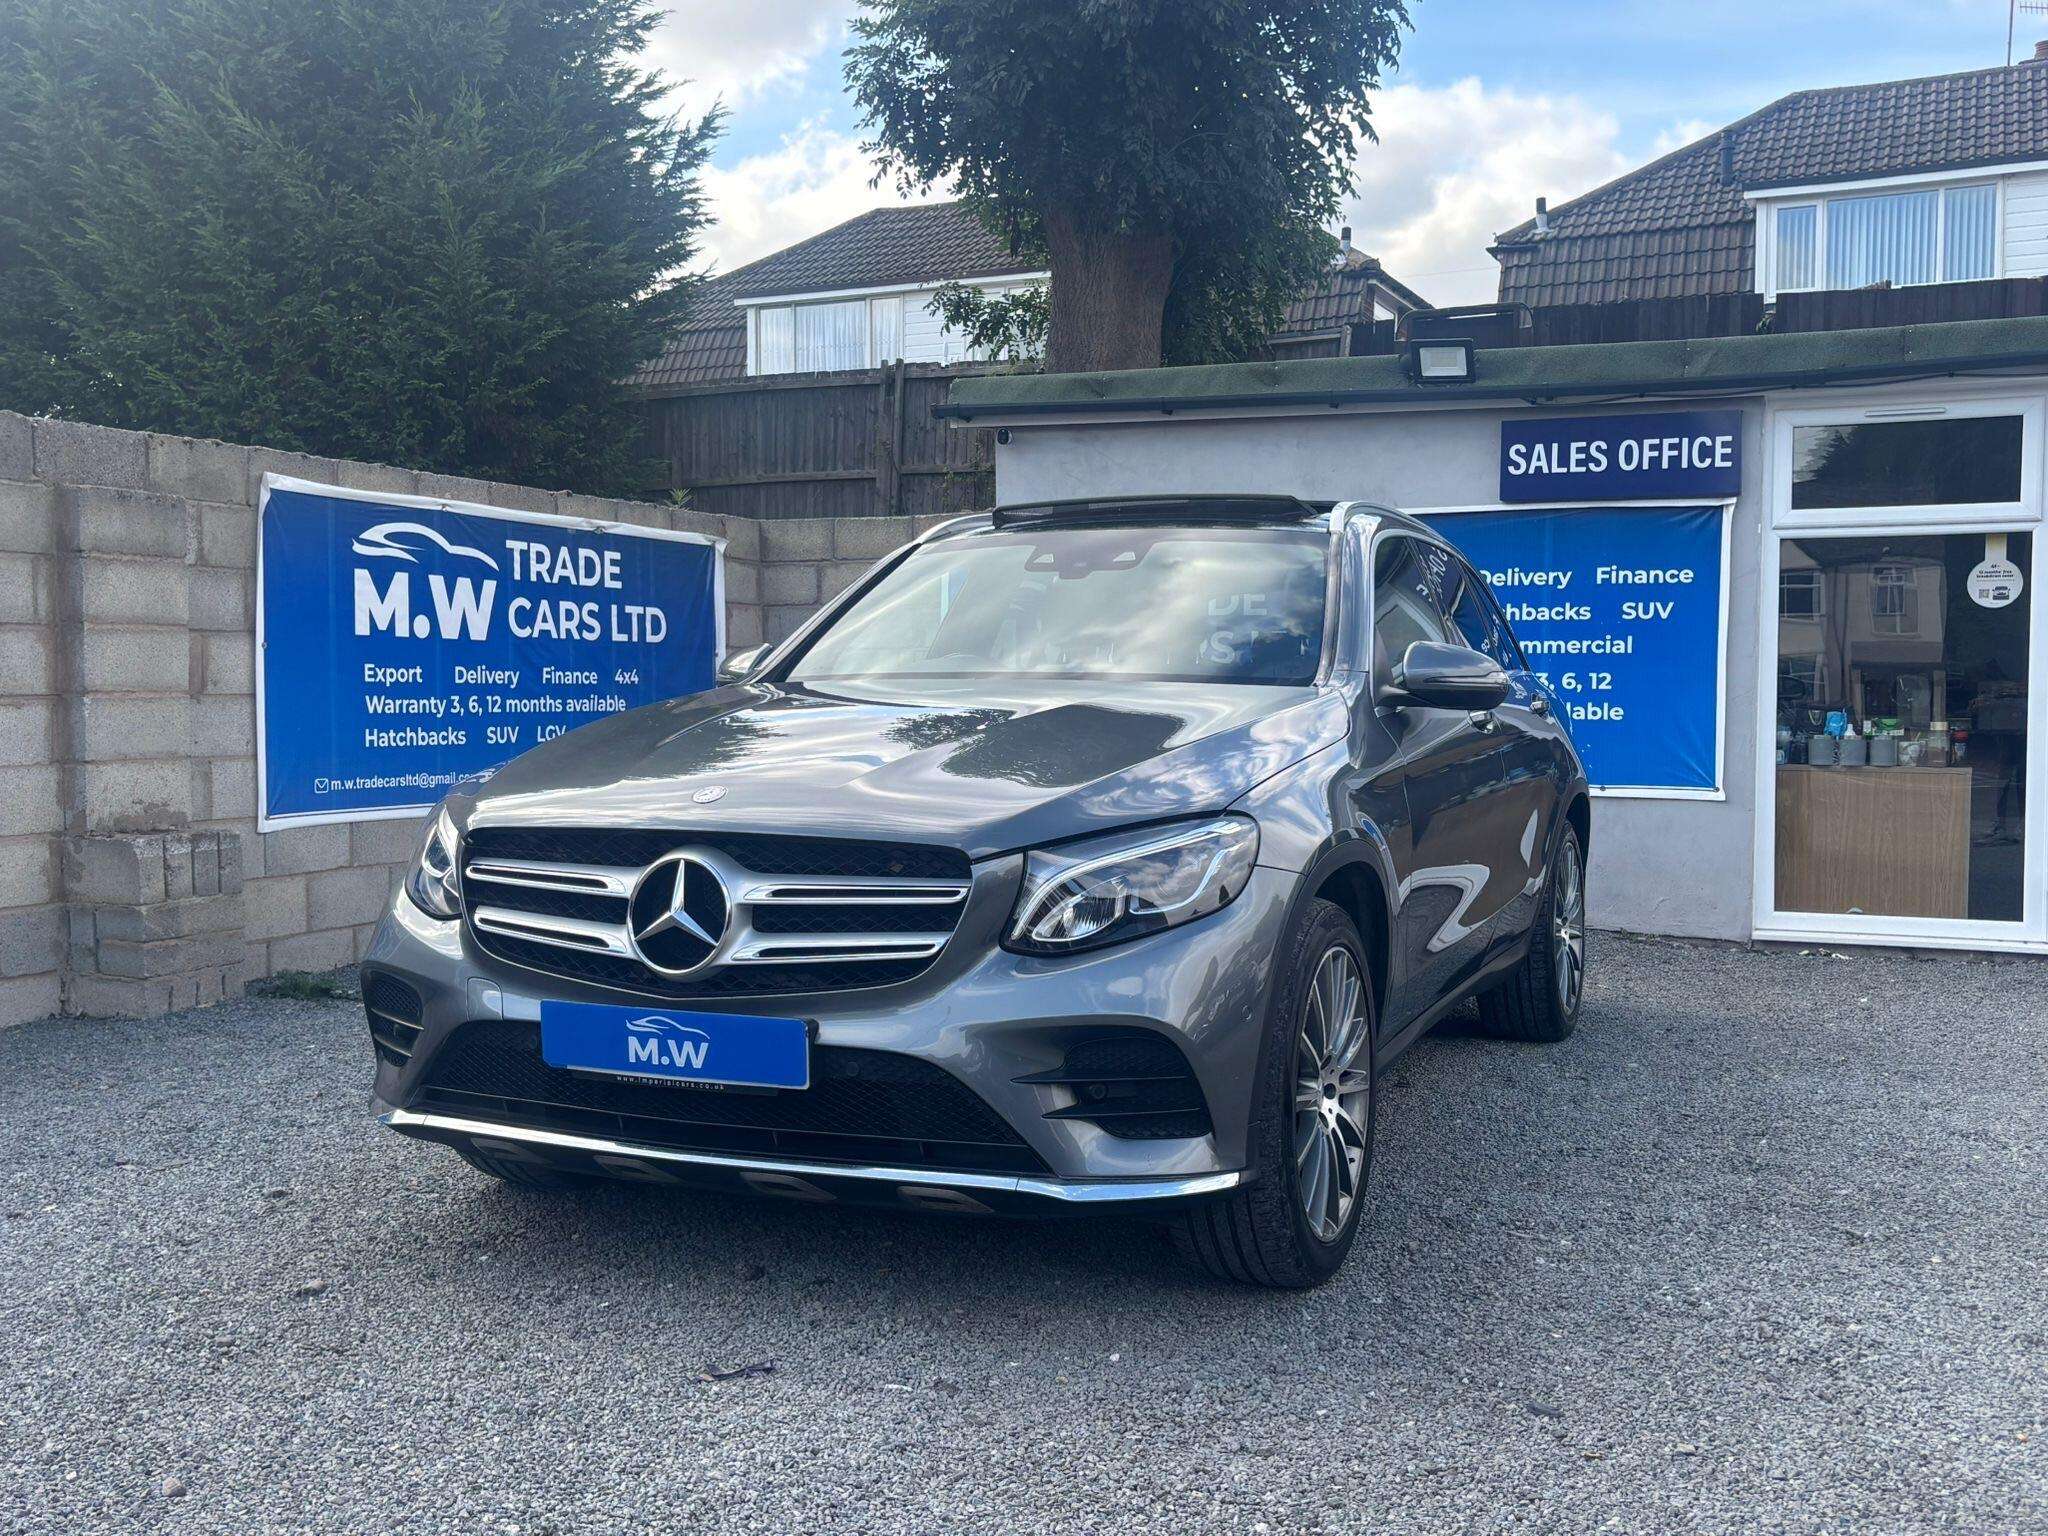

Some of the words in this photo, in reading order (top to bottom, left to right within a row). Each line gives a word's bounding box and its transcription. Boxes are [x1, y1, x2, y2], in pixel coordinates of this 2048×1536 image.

[1507, 441, 1608, 475] SALES
[1618, 435, 1733, 471] OFFICE
[505, 539, 623, 589] TRADE
[1596, 565, 1694, 585] Finance
[353, 567, 498, 641] M.W
[1503, 602, 1591, 621] hbacks
[1621, 602, 1674, 620] SUV
[508, 597, 601, 642] CARS
[611, 605, 667, 644] LTD
[1519, 635, 1633, 654] mmercial
[364, 664, 423, 687] Export
[454, 665, 520, 688] Delivery
[542, 666, 598, 685] Finance
[615, 669, 639, 685] 4x4
[1561, 672, 1583, 693] 6,
[1589, 672, 1612, 690] 12
[365, 694, 446, 718] Warranty
[450, 695, 464, 716] 3,
[468, 695, 482, 716] 6,
[486, 696, 502, 713] 12
[506, 695, 563, 712] months
[566, 695, 627, 712] available
[1565, 702, 1624, 720] lable
[365, 727, 467, 747] Hatchbacks
[486, 726, 519, 744] SUV
[537, 725, 567, 742] LGV
[330, 771, 473, 791] m.w.tradecarsltd@gmail.co
[627, 1036, 709, 1069] M.W
